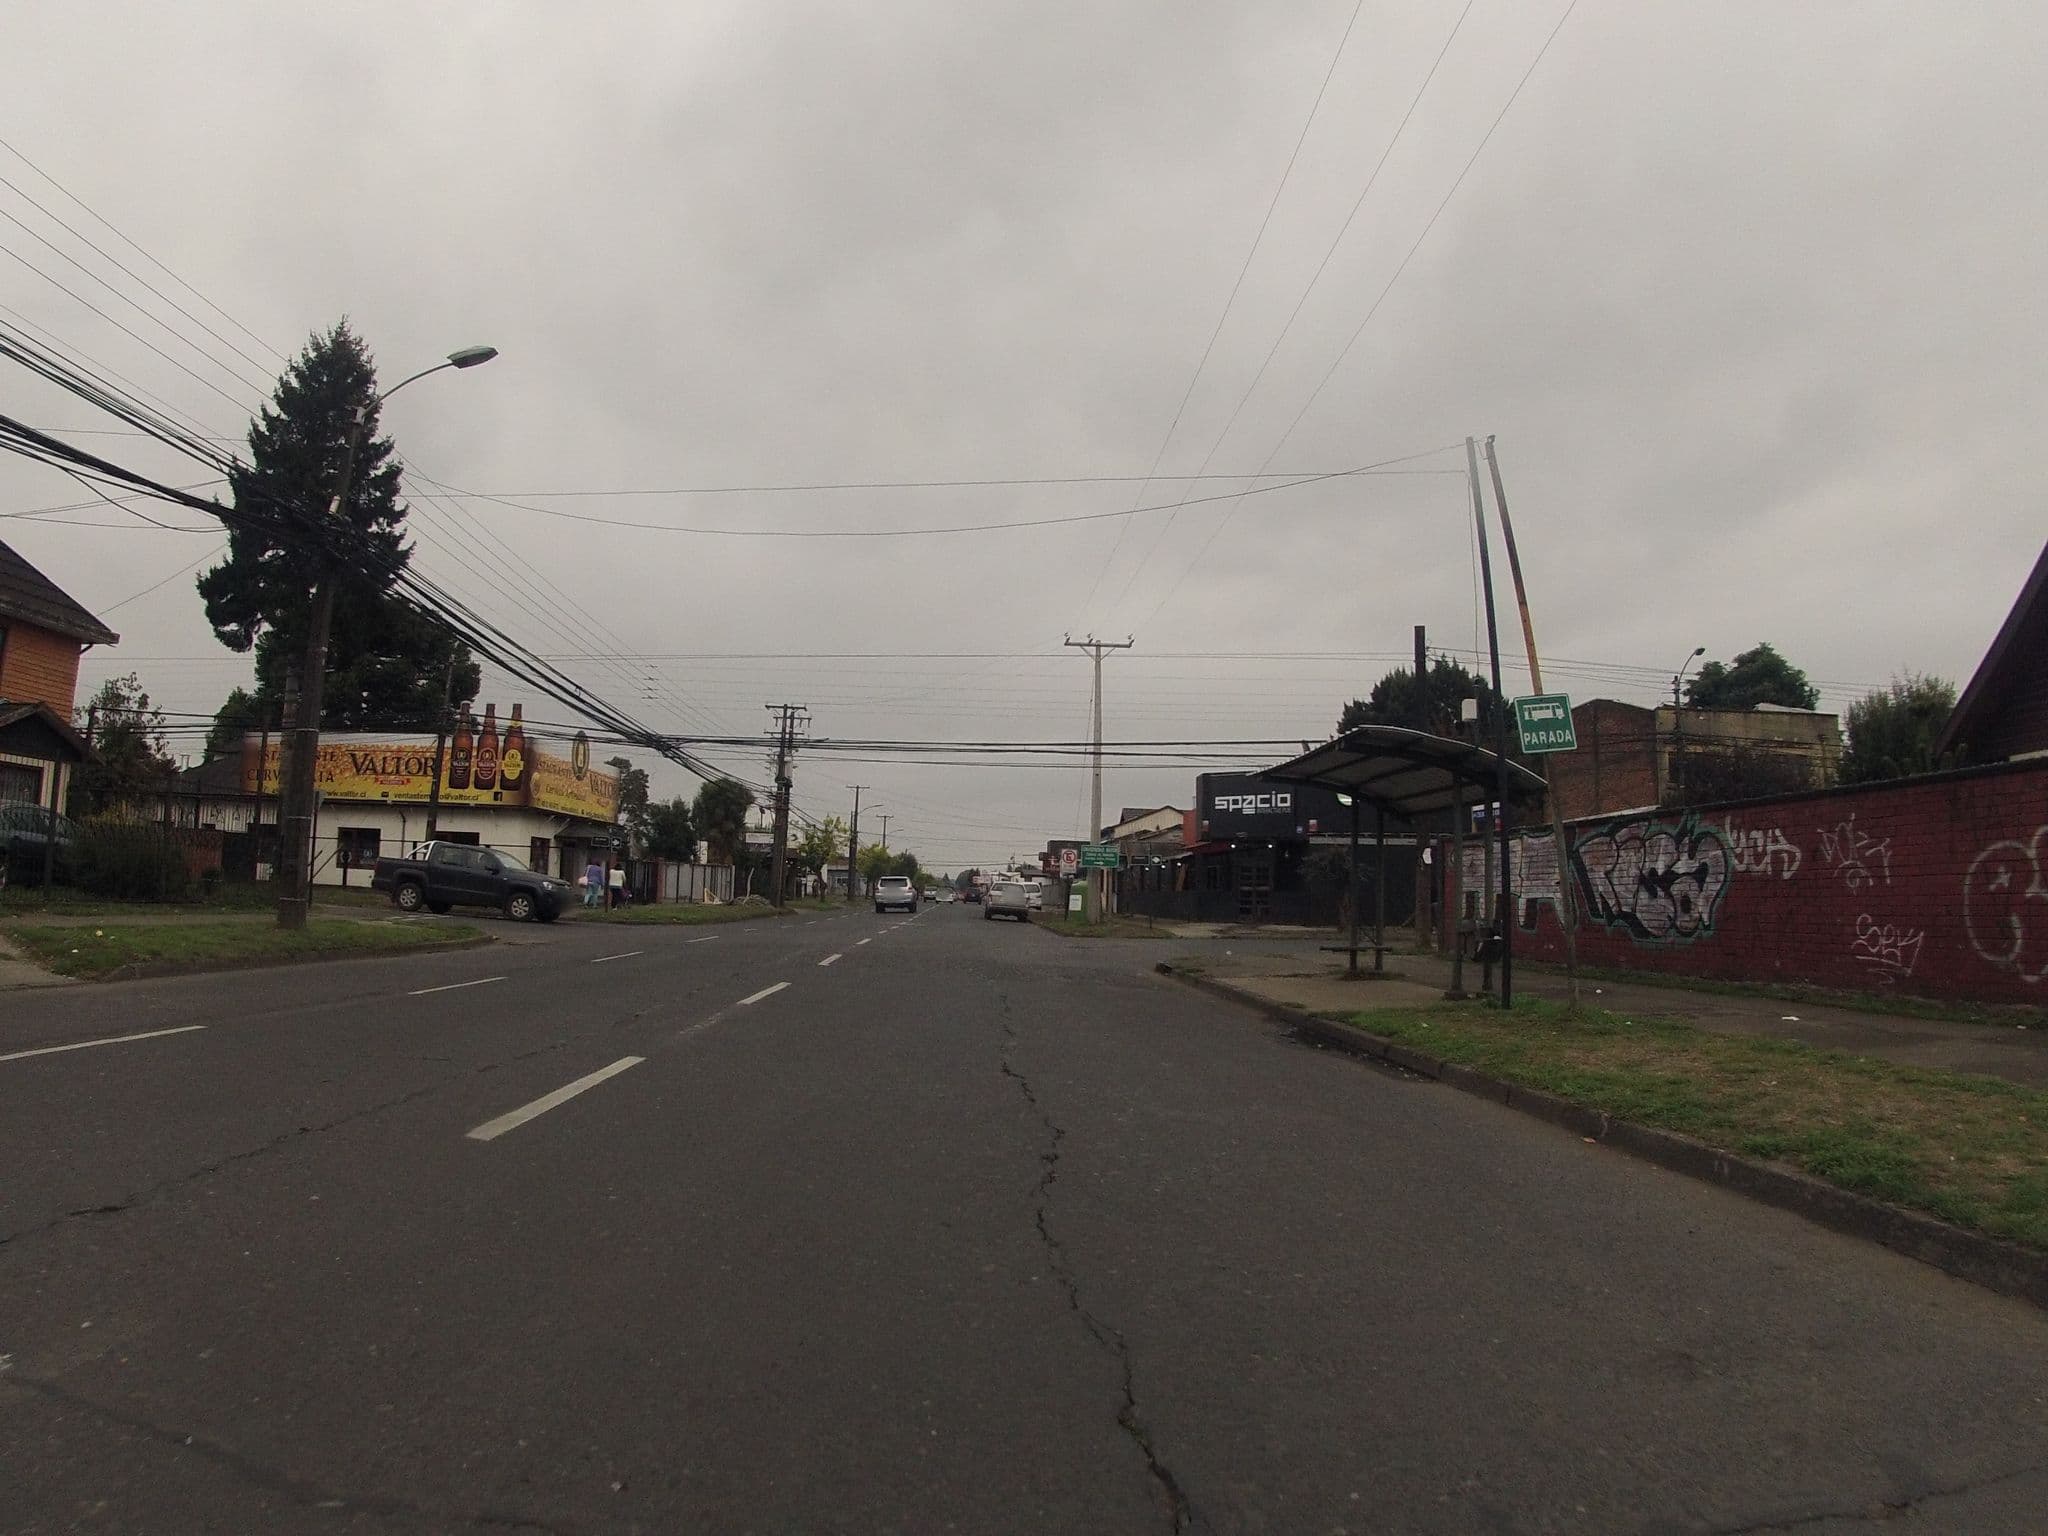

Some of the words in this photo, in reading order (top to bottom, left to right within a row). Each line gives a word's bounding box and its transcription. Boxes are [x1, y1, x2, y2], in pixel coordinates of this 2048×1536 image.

[1523, 729, 1575, 747] PARADA
[350, 751, 434, 776] VALTOR
[1215, 790, 1291, 815] spacio
